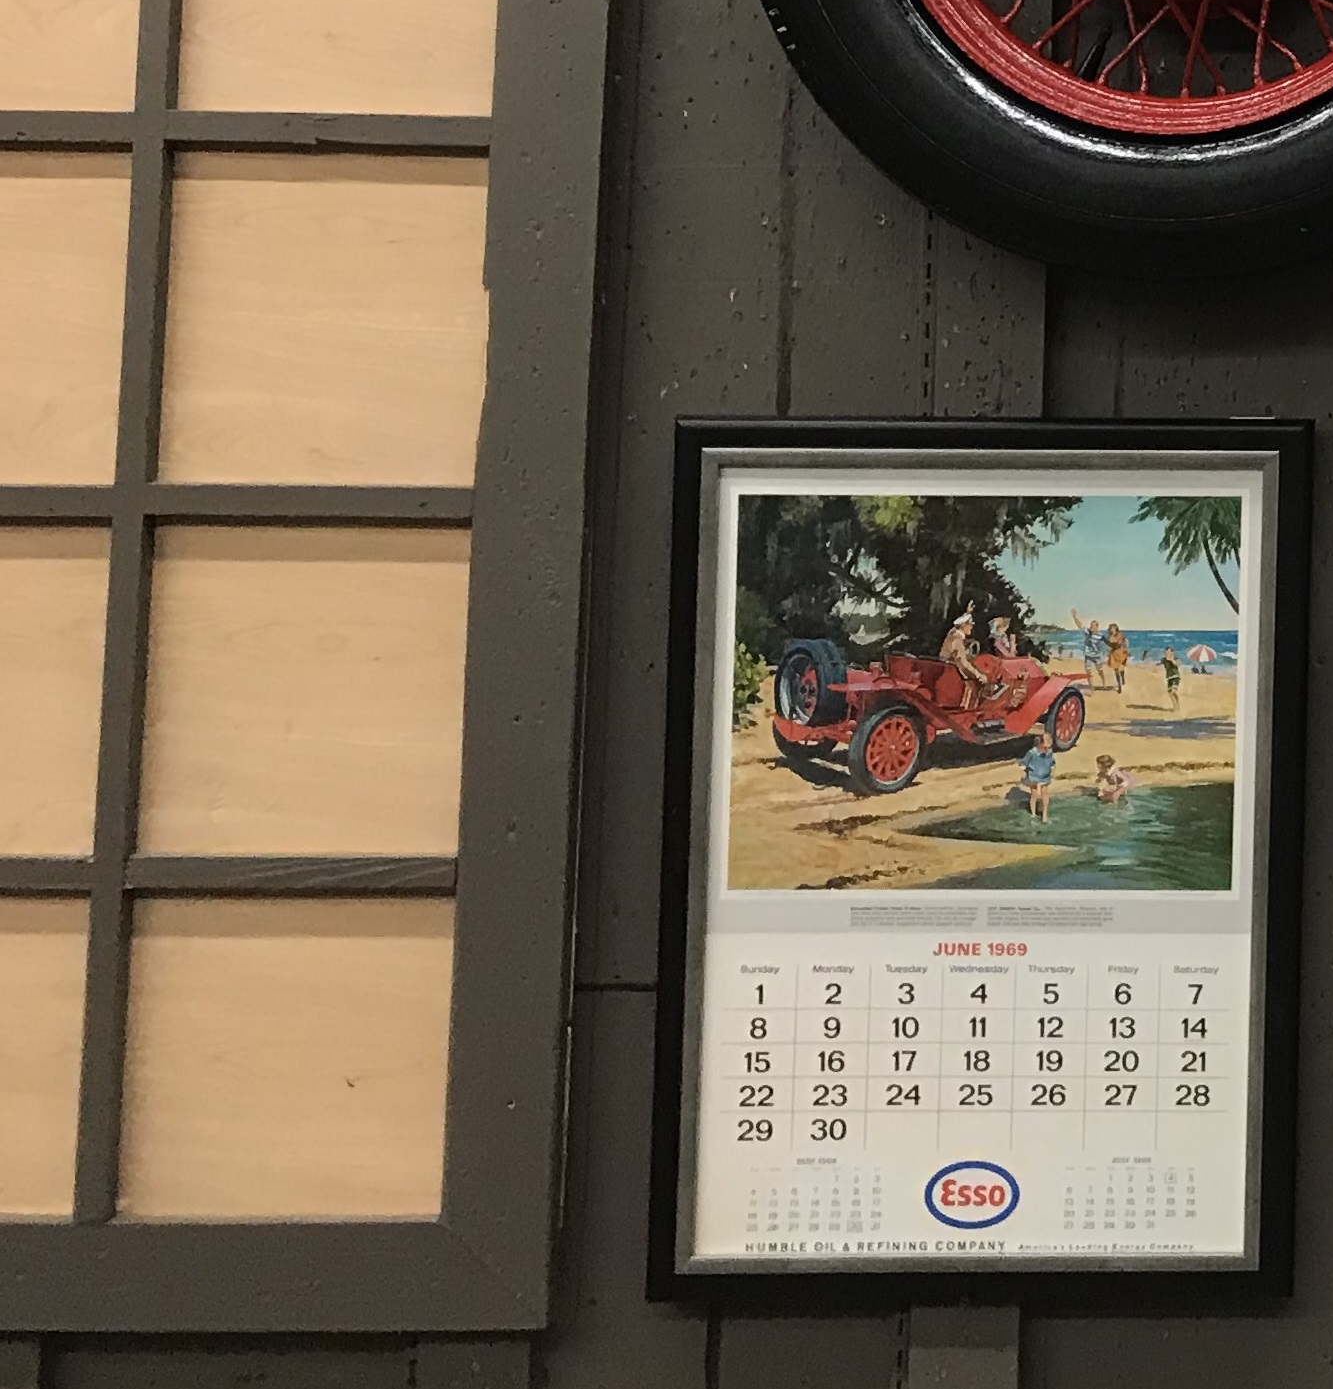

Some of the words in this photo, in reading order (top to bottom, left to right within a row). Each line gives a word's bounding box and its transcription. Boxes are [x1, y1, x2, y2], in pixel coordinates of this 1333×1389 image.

[932, 942, 981, 957] JUNE
[988, 942, 1028, 957] 1969
[812, 964, 854, 975] Monday
[1028, 964, 1075, 975] Thursday
[1108, 964, 1139, 975] Friday
[755, 983, 764, 1005] 1
[824, 982, 842, 1005] 2
[897, 982, 915, 1005] 3
[970, 983, 988, 1005] 4
[1043, 982, 1060, 1005] 5
[1114, 982, 1132, 1006] 6
[1187, 983, 1203, 1005] 7
[749, 1017, 768, 1040] 8
[823, 1016, 841, 1039] 9
[891, 1016, 920, 1039] 10
[969, 1016, 987, 1038] 11
[1037, 1016, 1064, 1039] 12
[1109, 1016, 1136, 1039] 13
[1181, 1017, 1208, 1039] 14
[744, 1051, 771, 1073] 15
[817, 1050, 845, 1073] 16
[892, 1050, 917, 1072] 17
[963, 1049, 991, 1073] 18
[1036, 1049, 1064, 1072] 19
[1103, 1049, 1140, 1073] 20
[1180, 1050, 1206, 1073] 21
[739, 1084, 774, 1108] 22
[812, 1083, 848, 1107] 23
[885, 1083, 921, 1106] 24
[958, 1083, 993, 1107] 25
[1030, 1083, 1067, 1107] 26
[1104, 1083, 1138, 1106] 27
[1175, 1084, 1211, 1107] 28
[736, 1119, 774, 1142] 29
[810, 1118, 847, 1141] 30
[745, 1241, 807, 1252] HUMBLE
[814, 1241, 836, 1252] OIL
[857, 1241, 928, 1252] REFINING
[935, 1240, 1006, 1251] COMPANY
